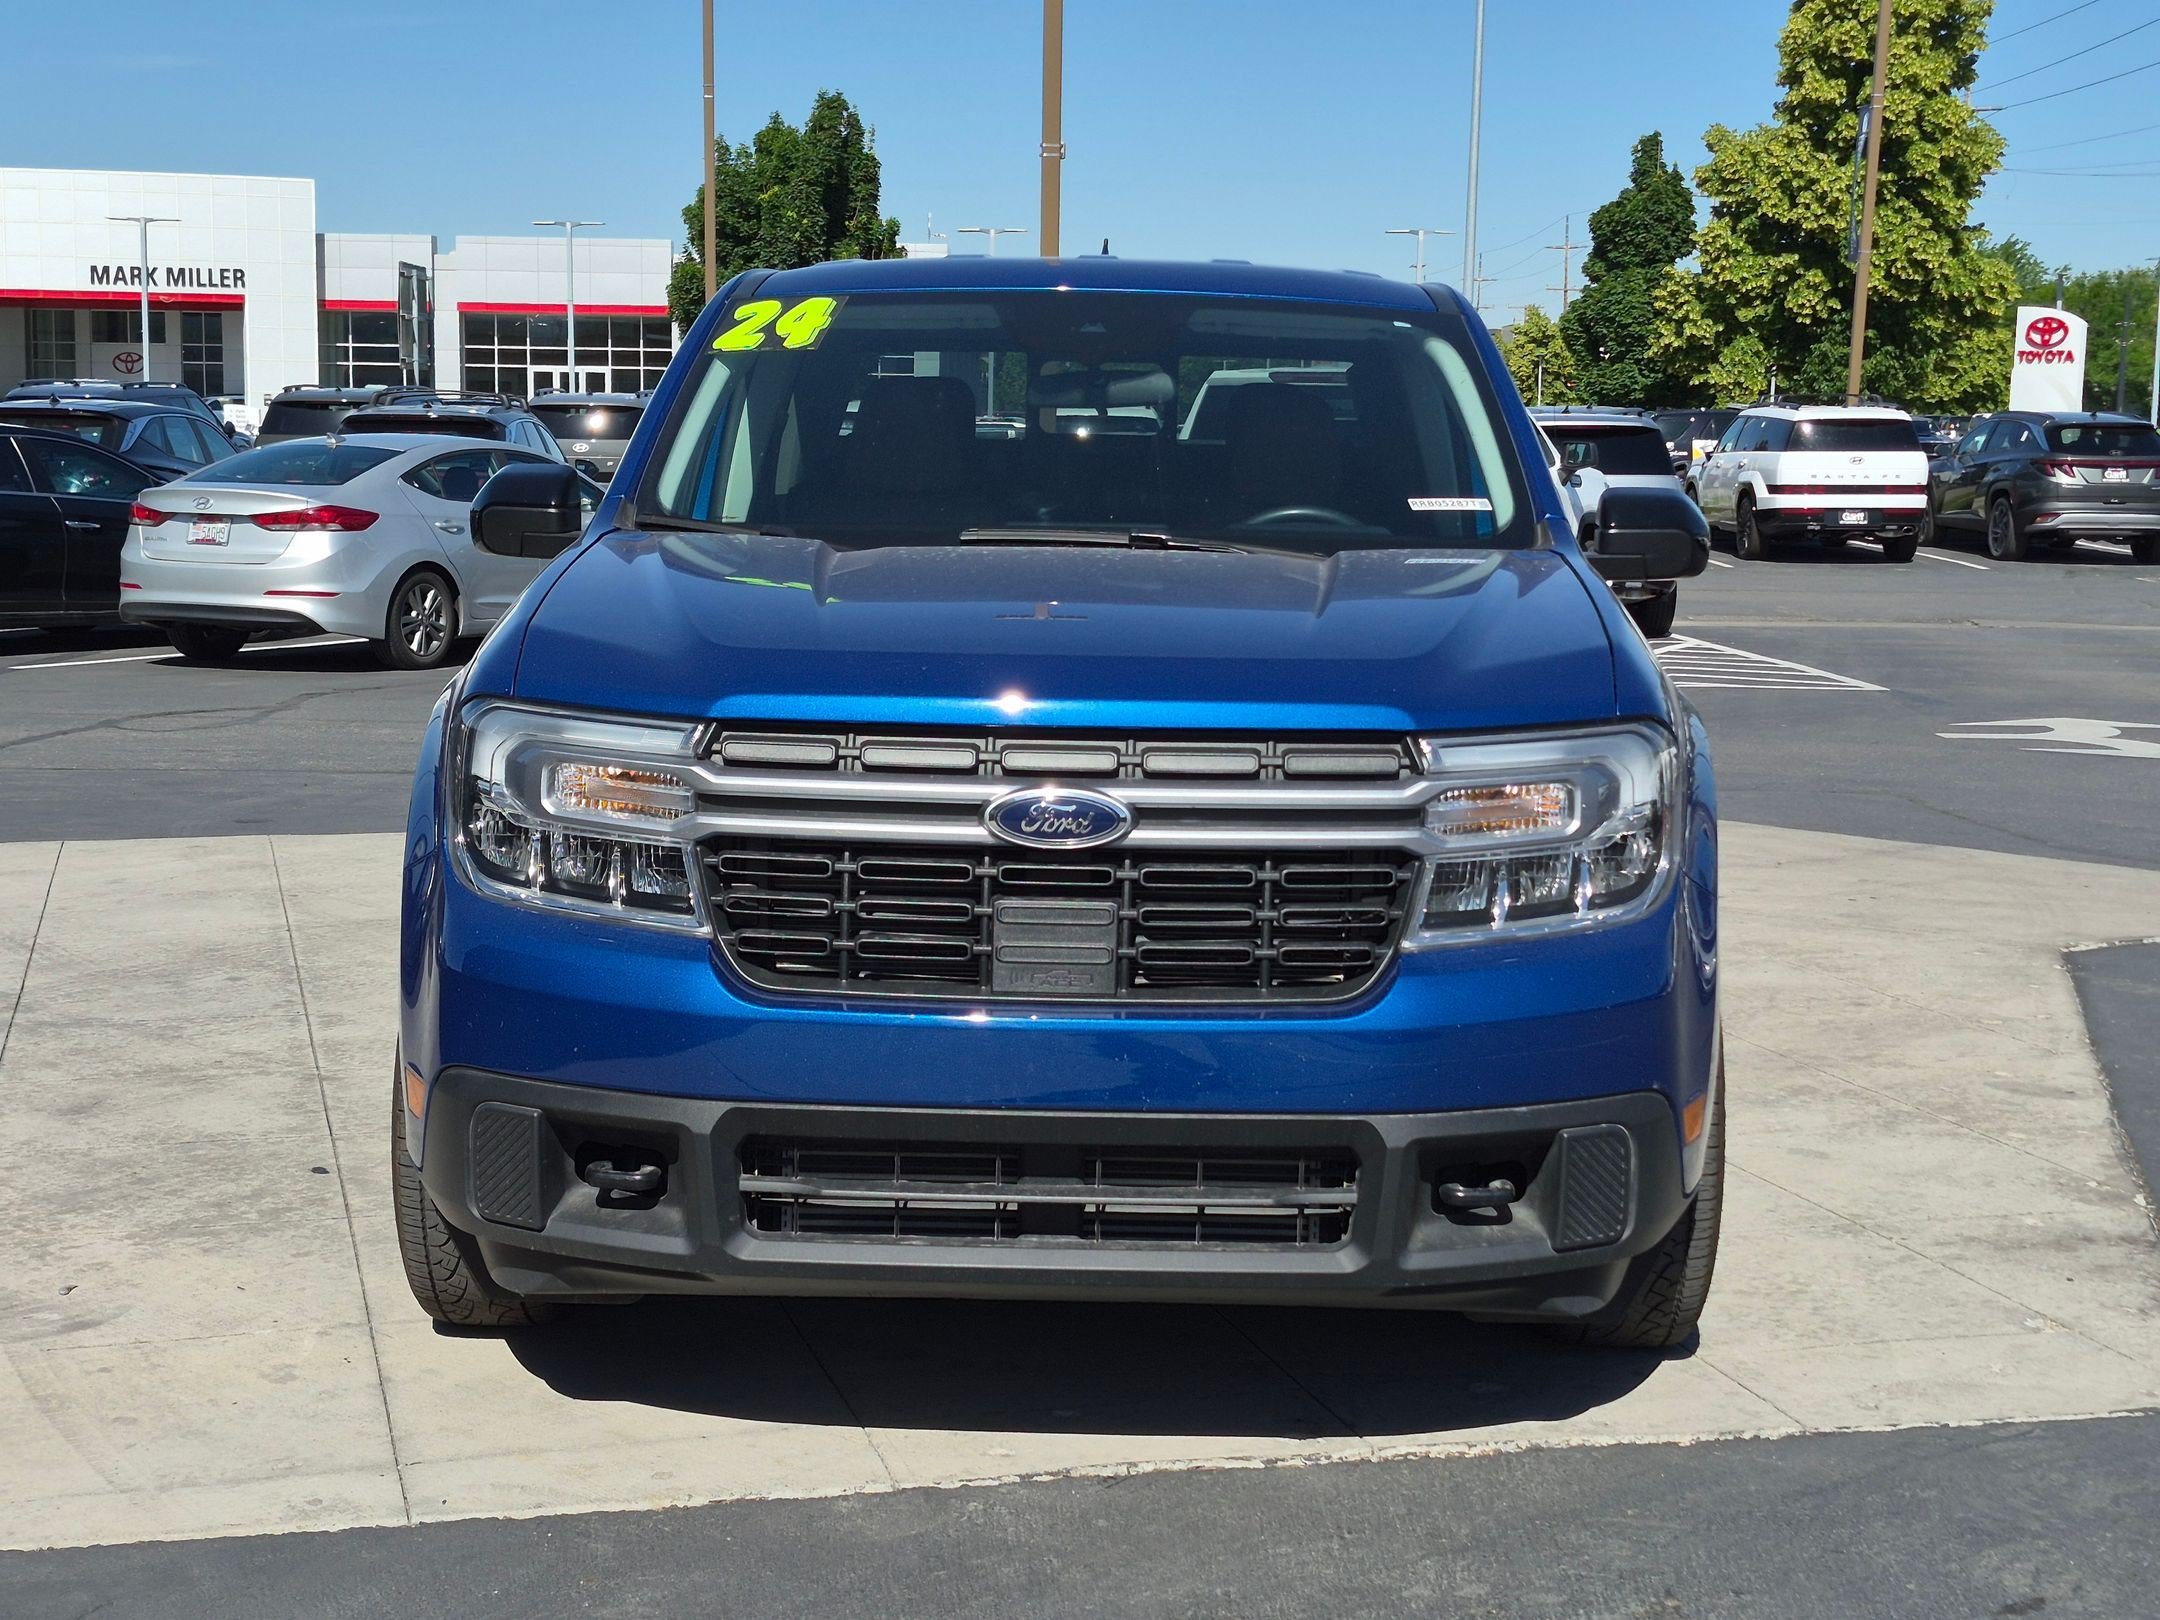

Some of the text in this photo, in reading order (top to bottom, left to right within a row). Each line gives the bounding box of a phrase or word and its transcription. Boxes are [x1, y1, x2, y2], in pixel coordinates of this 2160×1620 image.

[90, 265, 246, 288] MARK MILLER
[712, 297, 837, 351] 24
[2017, 350, 2075, 364] TOYOTA
[1021, 803, 1095, 834] Ford
